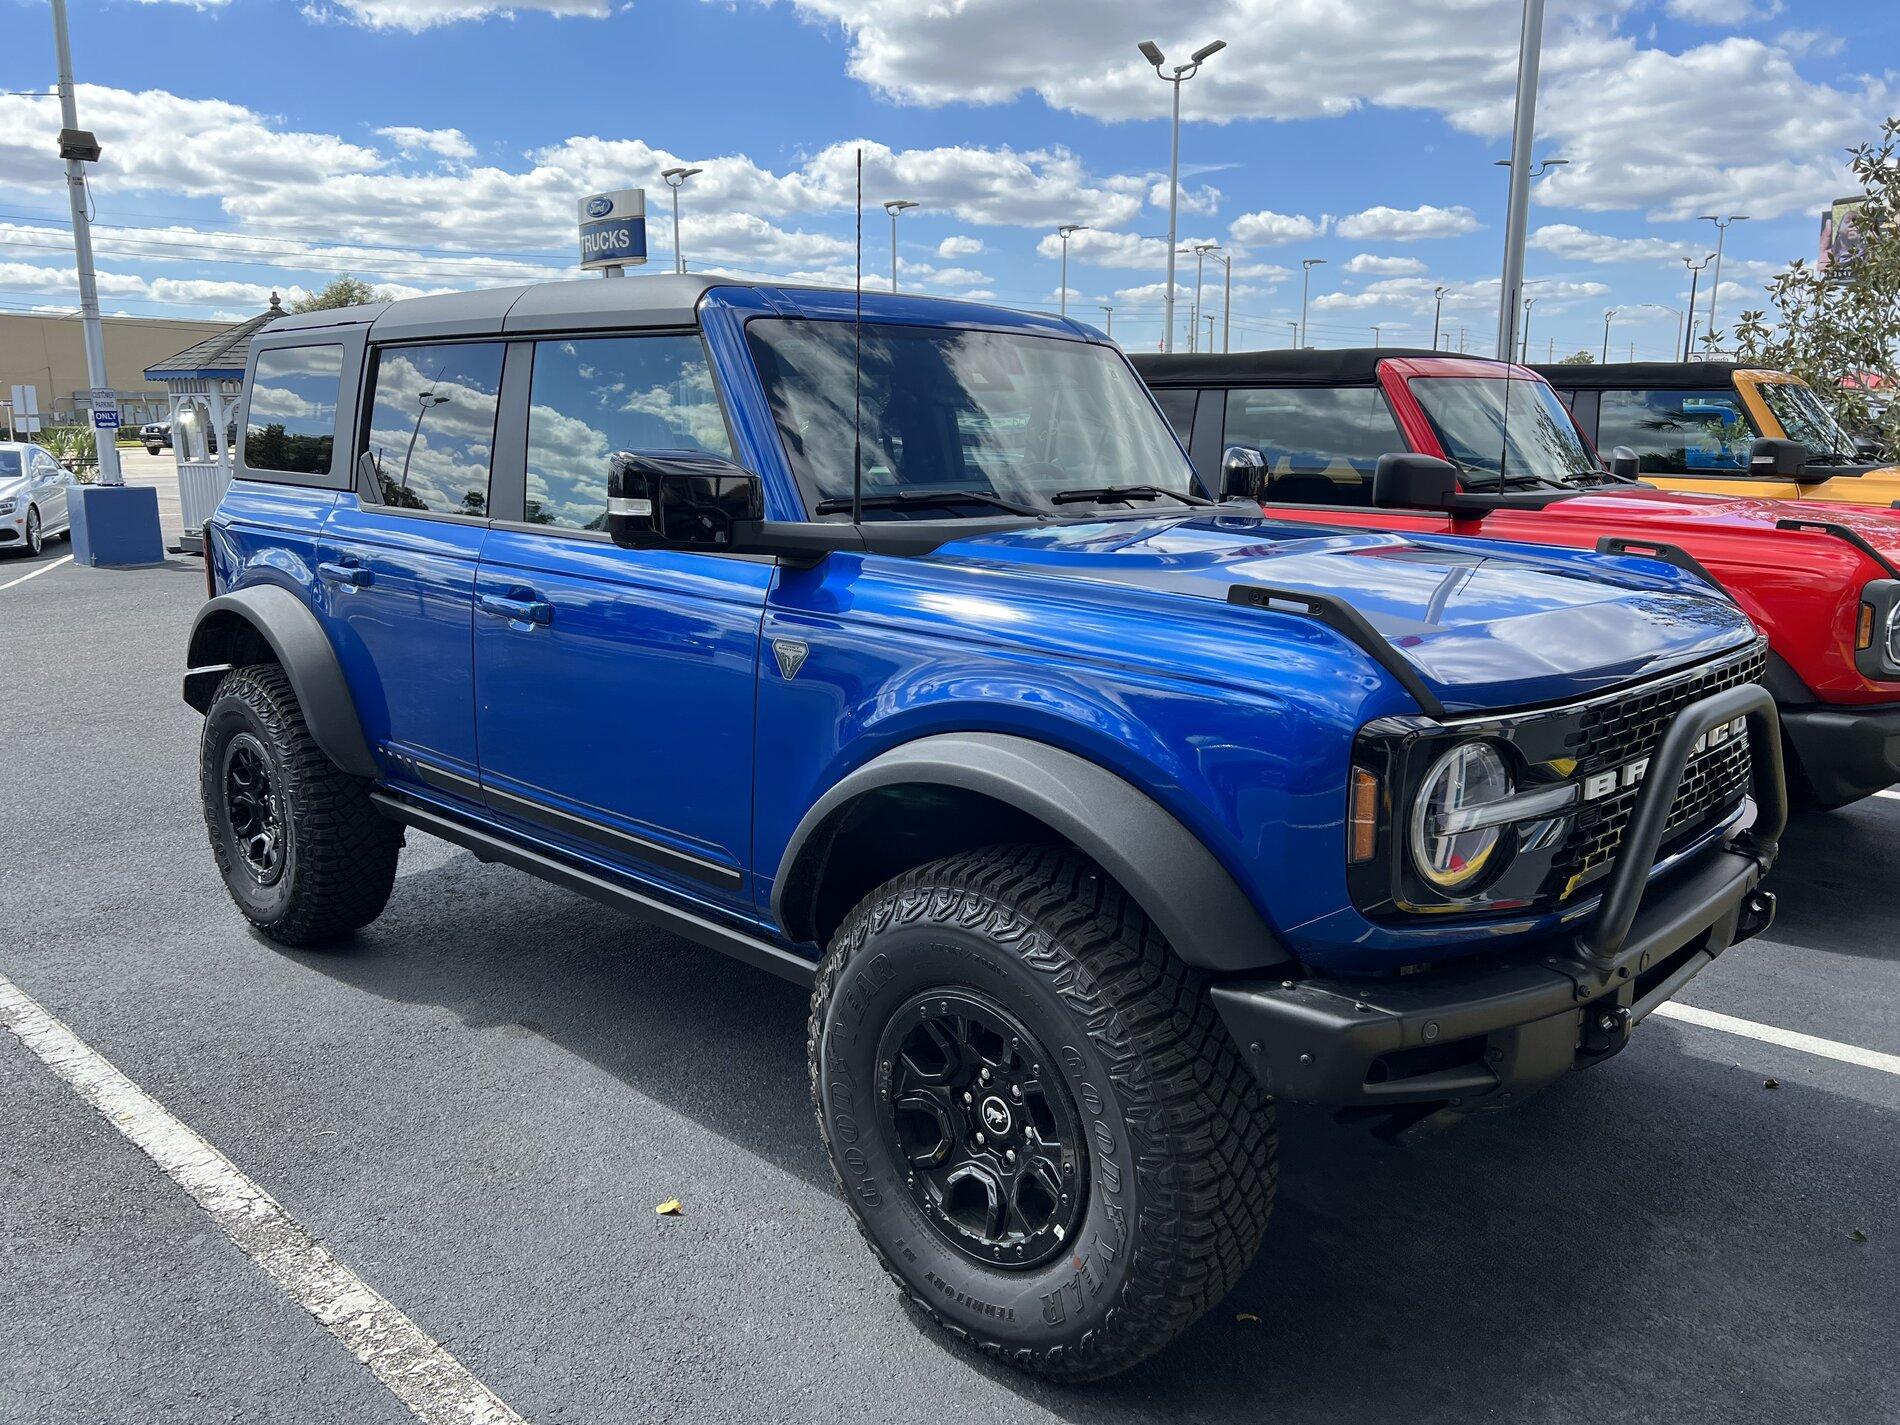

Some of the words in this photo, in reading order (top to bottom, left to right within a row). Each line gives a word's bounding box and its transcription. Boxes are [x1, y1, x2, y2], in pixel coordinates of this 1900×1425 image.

[581, 229, 630, 254] TRUCKS
[95, 412, 116, 420] ONLY
[1039, 1045, 1126, 1327] GOODYEAR
[924, 1271, 1016, 1323] TERRITORY
